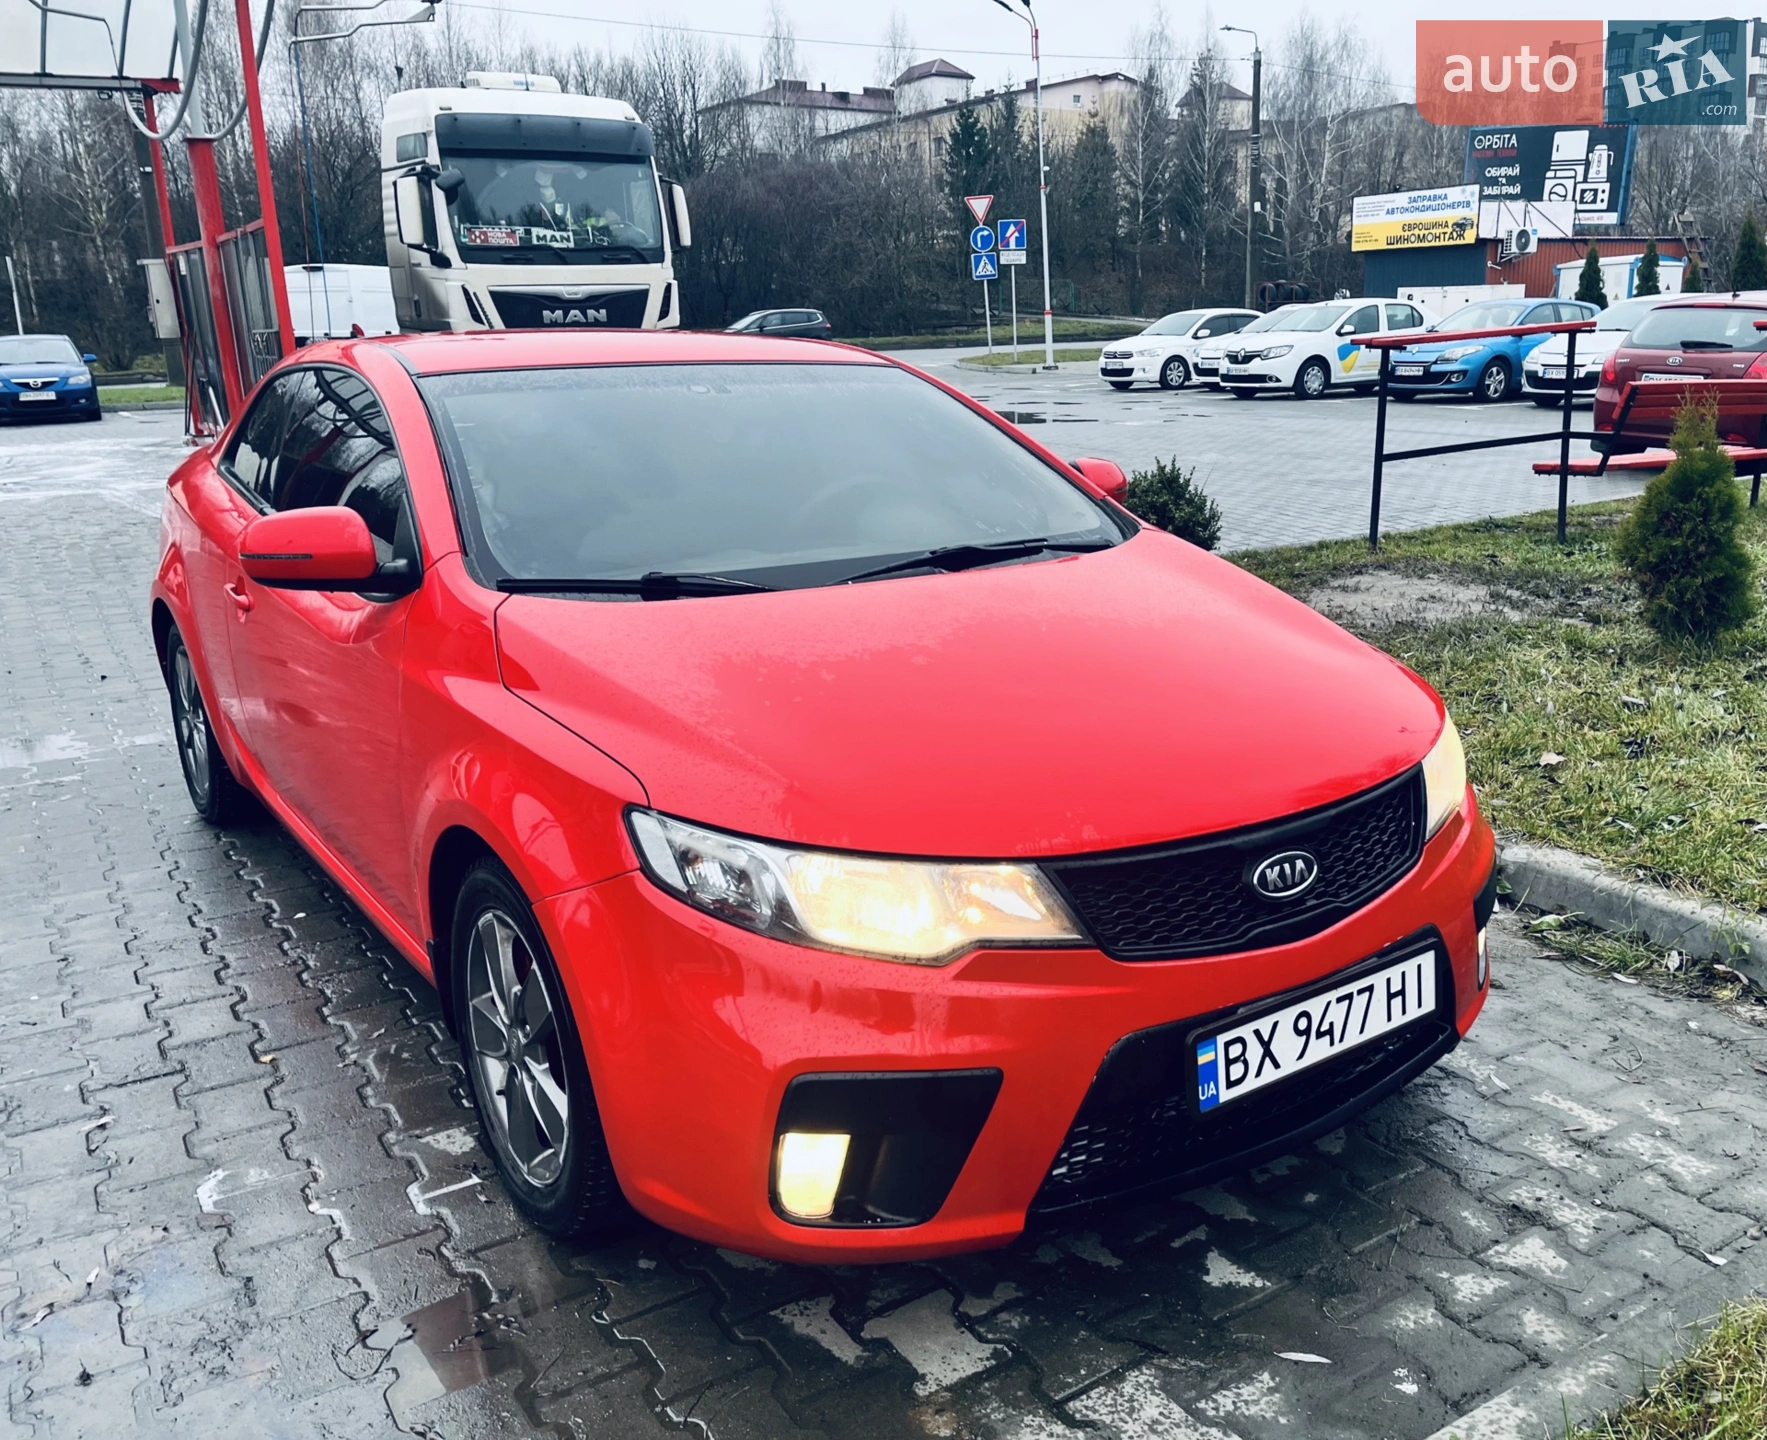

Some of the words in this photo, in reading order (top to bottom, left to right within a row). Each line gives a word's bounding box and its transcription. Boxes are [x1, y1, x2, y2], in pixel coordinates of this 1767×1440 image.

[1474, 133, 1518, 149] ОРБІТА
[1484, 163, 1520, 177] ОБИРАЙ
[1407, 193, 1449, 205] ЗАПРАВКА
[1385, 200, 1471, 216] АВТОКОНДИЦІОНЕРІВ
[1402, 220, 1450, 233] ЄВРОШИНА
[487, 237, 515, 245] ПОШТА
[535, 234, 572, 244] MAN
[1386, 231, 1466, 246] ШИНОМОНТАЖ
[542, 309, 608, 324] MAN
[1264, 858, 1310, 891] KIA
[1223, 1020, 1281, 1091] BX
[1292, 983, 1375, 1062] 9477
[1385, 963, 1423, 1023] HI
[1198, 1080, 1217, 1101] UA
